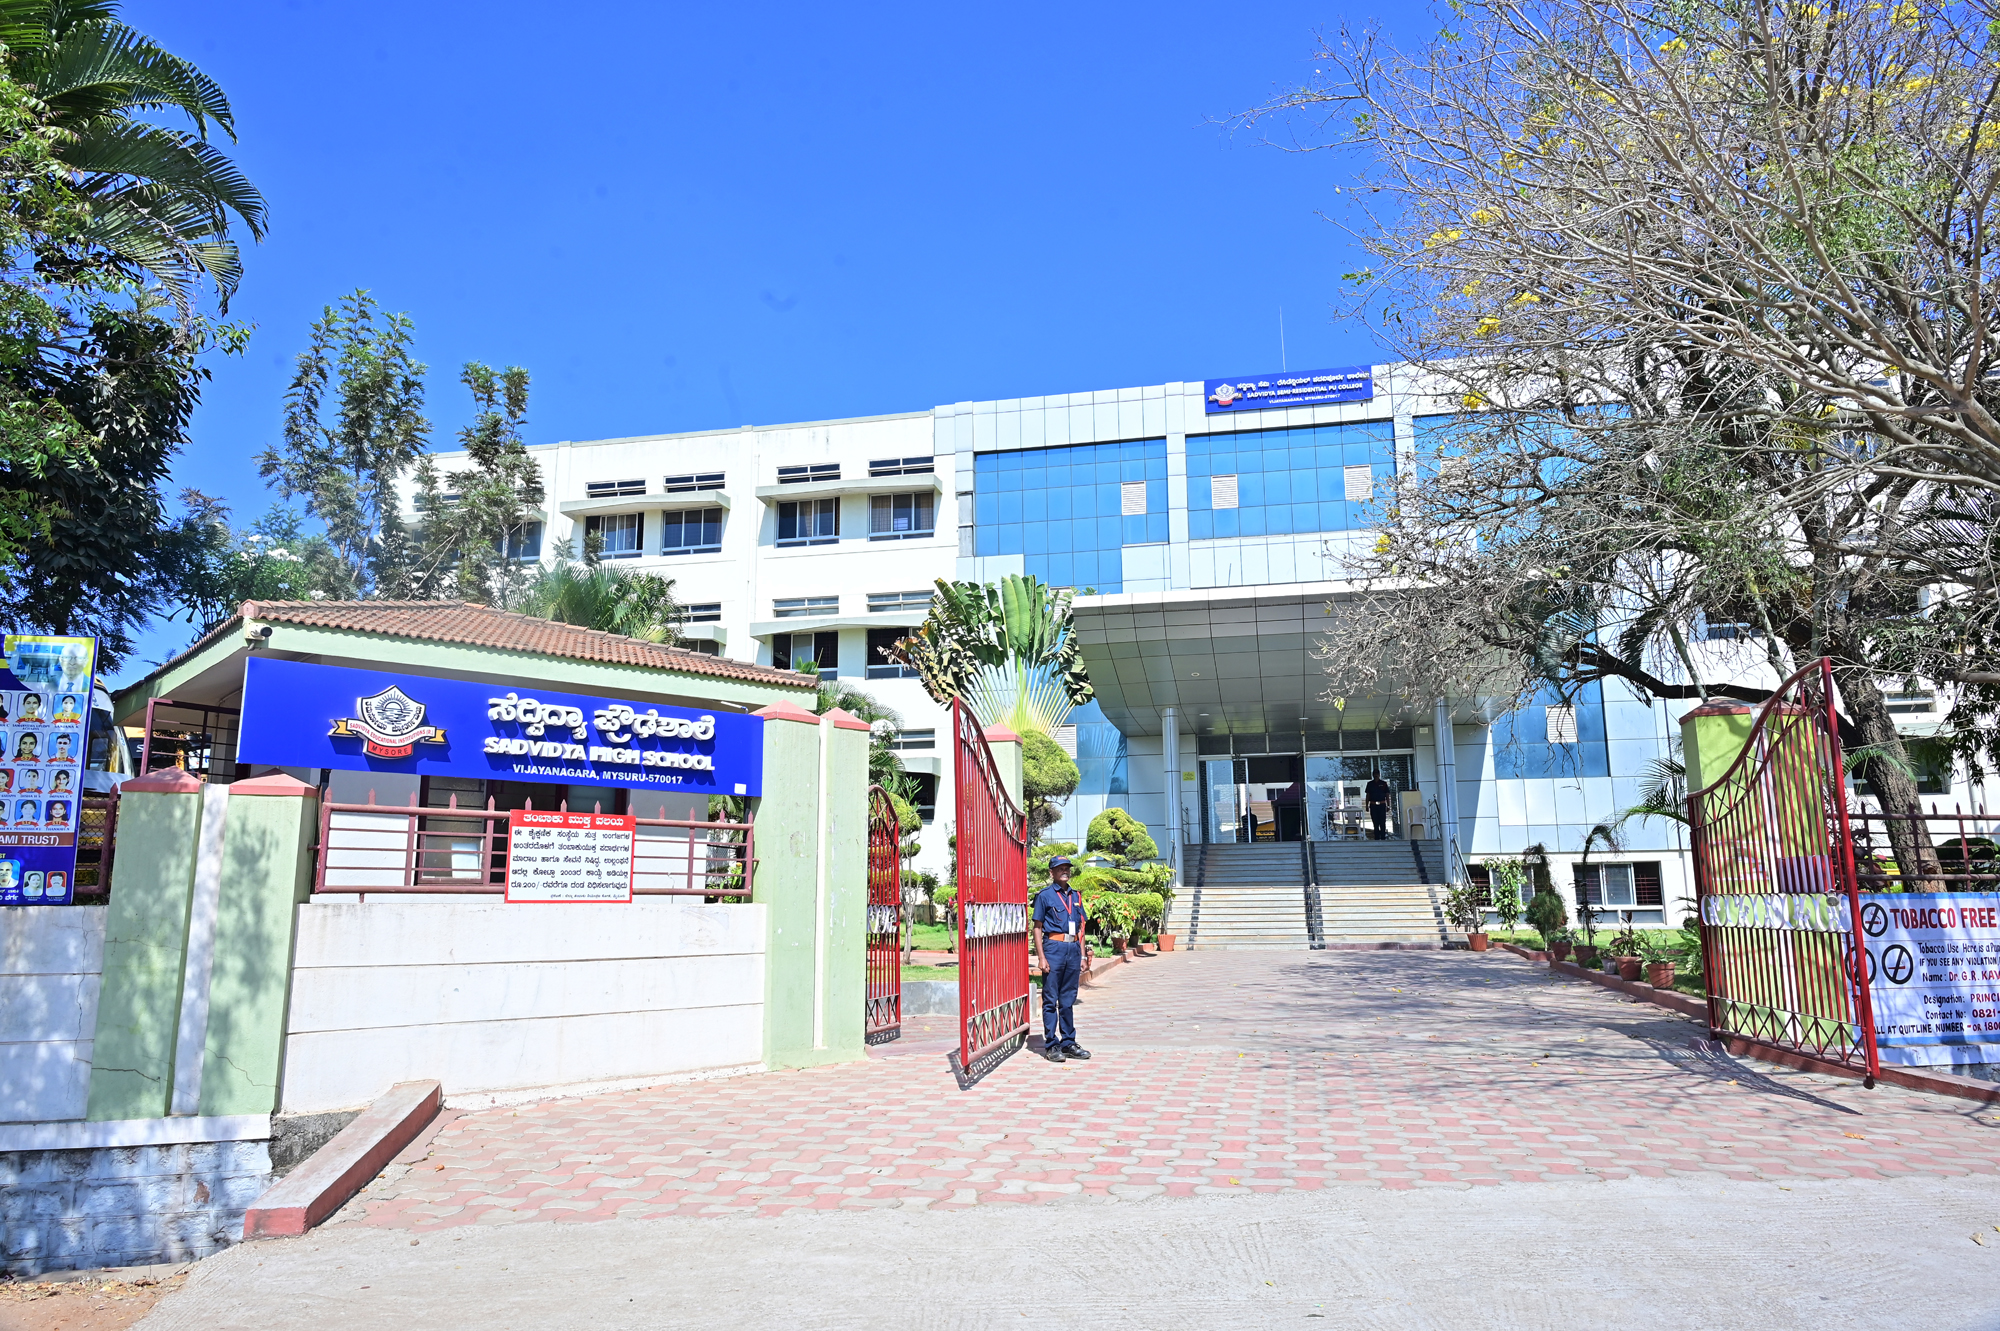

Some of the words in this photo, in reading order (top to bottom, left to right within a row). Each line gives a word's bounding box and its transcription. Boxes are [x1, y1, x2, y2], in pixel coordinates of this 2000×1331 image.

[1246, 390, 1276, 399] SADVIDYA
[1277, 386, 1327, 396] SEMI-RESIDENTIAL
[350, 722, 370, 735] SADVIDYA
[370, 732, 397, 744] EDUCATIONAL
[398, 729, 426, 744] INSTITUTIONS
[371, 745, 409, 755] MYSORE
[484, 737, 586, 762] SADVIDYA
[590, 745, 640, 764] HIGH
[642, 750, 715, 770] SCHOOL
[513, 764, 600, 780] VIJAYANAGARA,
[602, 771, 682, 784] MYSURU-570017
[523, 814, 564, 824] ತಂಬಾಕು
[568, 816, 591, 828] ಮುಕ್ತ
[596, 816, 624, 826] ವಲಯ
[21, 836, 59, 846] TRUST)
[1890, 908, 1956, 929] TOBACCO
[1960, 908, 1997, 928] FREE
[1918, 943, 1945, 954] Tobacco
[1947, 943, 1959, 953] Use
[1963, 943, 1976, 953] Here
[1978, 943, 1984, 952] is
[1920, 958, 1925, 966] IF
[1927, 958, 1938, 966] YOU
[1940, 957, 1950, 966] SEE
[1952, 957, 1964, 966] ANY
[1924, 994, 1965, 1007] Designation:
[1970, 993, 2000, 1003] PRINCI
[1926, 1010, 1952, 1019] Contact
[1955, 1010, 1966, 1019] No:
[1888, 1026, 1897, 1034] AT
[1899, 1024, 1932, 1035] QUITLINE
[1936, 1022, 1964, 1032] NUMBER
